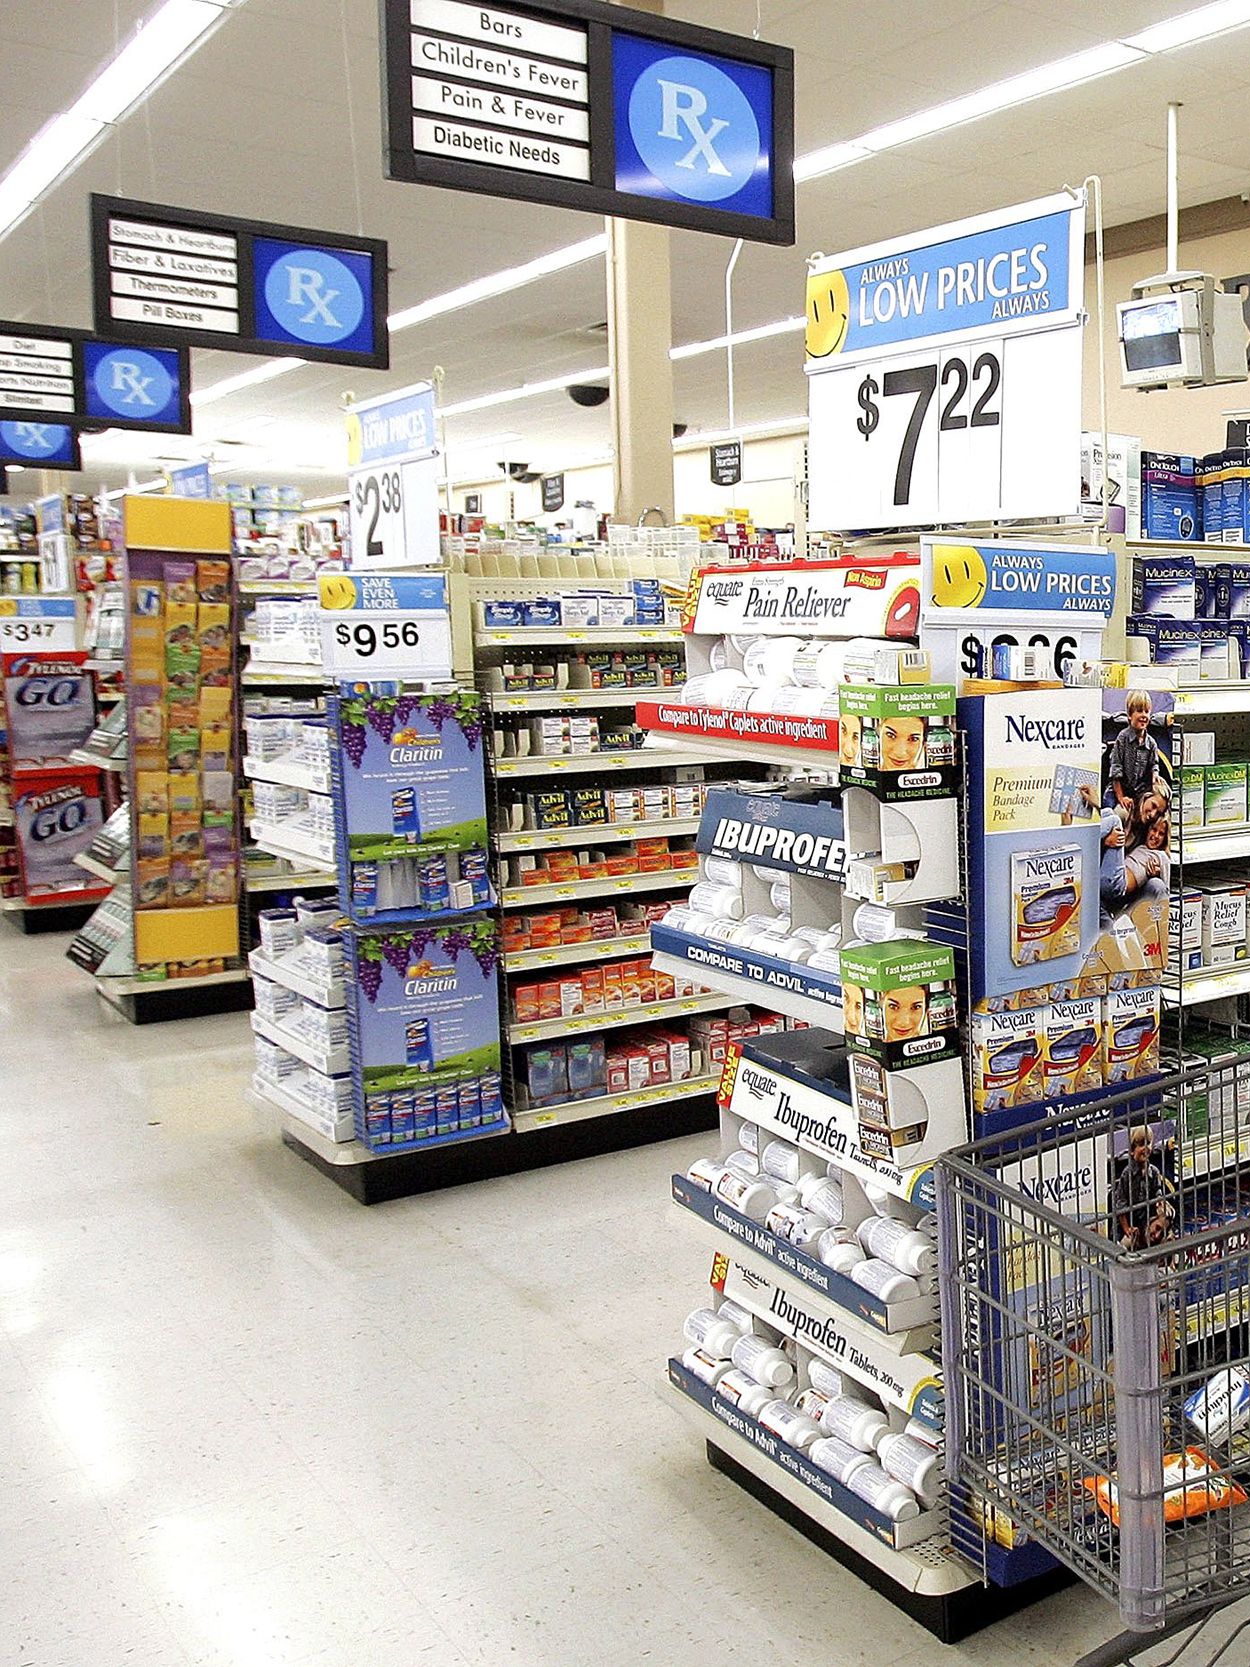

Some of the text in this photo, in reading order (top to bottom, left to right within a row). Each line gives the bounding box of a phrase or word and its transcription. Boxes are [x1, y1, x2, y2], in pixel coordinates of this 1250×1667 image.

[480, 12, 522, 39] Bars
[421, 42, 579, 92] Children's Fever
[441, 86, 564, 126] Pain & Fever
[434, 127, 560, 165] Diabetic Needs
[112, 250, 150, 267] Fiber
[171, 258, 235, 278] Laxatives
[861, 258, 909, 284] ALWAYS
[130, 277, 217, 299] Thermometers
[859, 242, 1048, 327] LOW PRICES
[142, 304, 202, 323] Pill Boxes
[991, 290, 1050, 319] ALWAYS
[992, 555, 1044, 570] ALWAYS
[1146, 567, 1193, 578] Mucinex
[361, 578, 392, 588] SAVE
[706, 580, 744, 599] equate
[991, 570, 1112, 595] LOW PRICES
[362, 589, 395, 599] EVEN
[743, 586, 851, 619] Pain Reliever
[363, 599, 398, 609] MORE
[1063, 598, 1112, 611] ALWAYS
[1159, 629, 1199, 640] Mucinex
[885, 691, 951, 702] Fast headache relief
[898, 703, 919, 711] begins
[658, 704, 689, 728] Compare
[690, 711, 699, 725] to
[729, 715, 759, 733] Caplets
[759, 718, 783, 734] active
[784, 719, 828, 742] ingredient
[1005, 714, 1085, 749] Nexcare
[606, 733, 630, 744] Advil
[390, 747, 443, 763] Claritin
[903, 774, 937, 786] Excedrin
[993, 776, 1052, 794] Premium
[540, 794, 565, 804] Advil
[576, 790, 601, 801] Advil
[993, 794, 1035, 806] Bandage
[542, 812, 568, 823] Advil
[579, 808, 605, 819] Advil
[993, 808, 1016, 822] Pack
[1026, 855, 1074, 879] Nexcare
[1214, 901, 1242, 911] Mucus
[1214, 909, 1238, 920] Relief
[1214, 919, 1237, 930] Cough
[1143, 944, 1161, 956] 3M
[687, 946, 743, 974] COMPARE
[747, 963, 764, 980] TO
[885, 965, 900, 976] Fast
[900, 960, 932, 973] headache
[932, 956, 950, 967] relief
[405, 977, 457, 996] Claritin
[899, 973, 921, 982] begins
[1116, 989, 1155, 1009] Nexcare
[1051, 1000, 1094, 1020] Nexcare
[1146, 1007, 1155, 1015] 3M
[991, 1010, 1036, 1032] Nexcare
[1047, 1024, 1074, 1034] Premium
[987, 1034, 1014, 1045] Premium
[1026, 1030, 1036, 1038] 3M
[908, 1040, 941, 1054] Excedrin
[855, 1061, 879, 1080] Excedrin
[742, 1068, 776, 1095] equate
[858, 1093, 884, 1113] Excedrin
[774, 1092, 848, 1154] Ibuprofen
[860, 1126, 889, 1145] Excedrin
[713, 1205, 745, 1237] Compare
[745, 1226, 754, 1242] to
[777, 1246, 797, 1269] active
[796, 1256, 830, 1290] ingredient
[770, 1288, 905, 1398] Ibuprofen Tablets, 200 mg
[711, 1396, 745, 1430] Compare
[745, 1420, 755, 1437] to
[779, 1449, 800, 1471] active
[800, 1463, 833, 1498] ingredient
